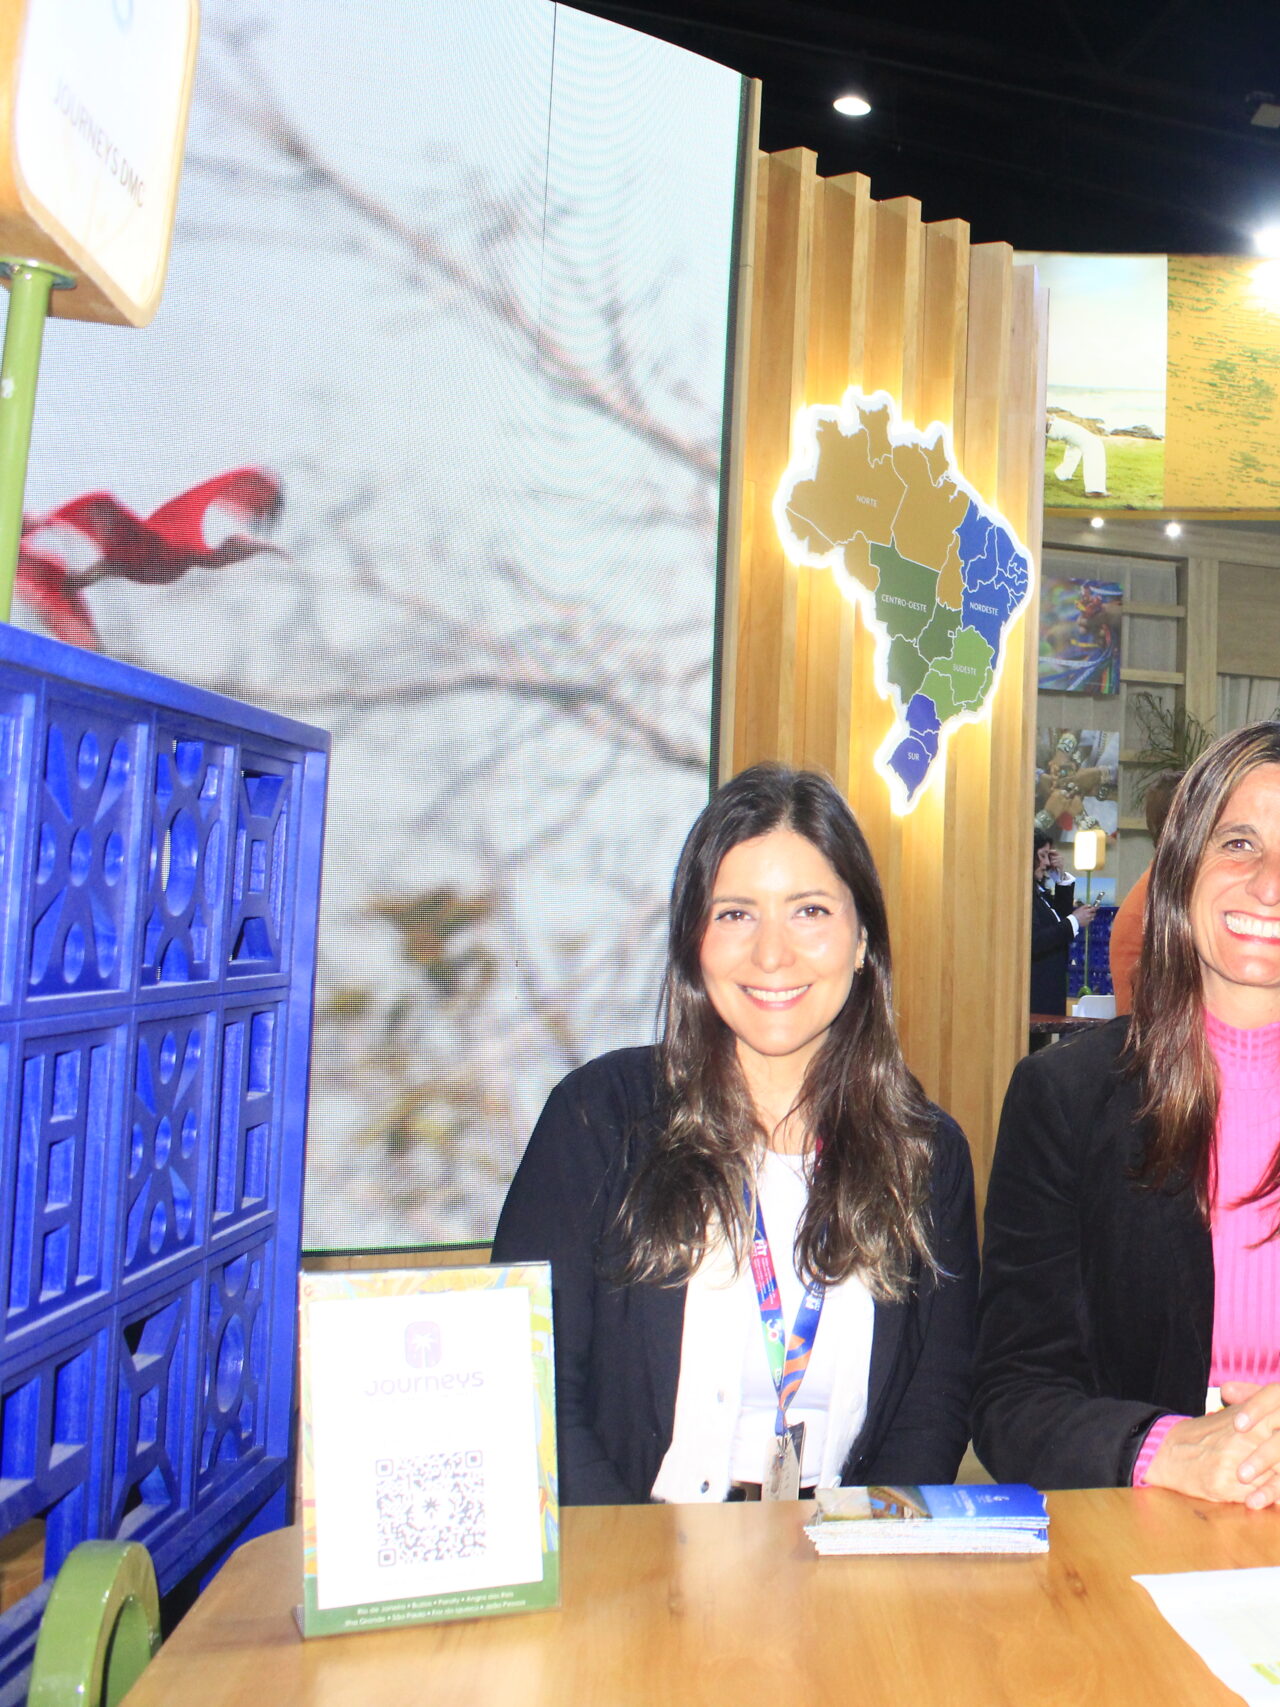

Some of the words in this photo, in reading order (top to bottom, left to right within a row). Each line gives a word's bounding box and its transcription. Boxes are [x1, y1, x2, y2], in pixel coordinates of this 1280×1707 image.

[53, 77, 118, 176] JOURNEYS
[119, 159, 144, 207] DMC
[856, 494, 878, 507] NORTE
[881, 593, 927, 612] CENTRO-OESTE
[969, 602, 999, 616] NORDESTE
[952, 662, 977, 676] SUDESTE
[907, 751, 920, 761] SUR
